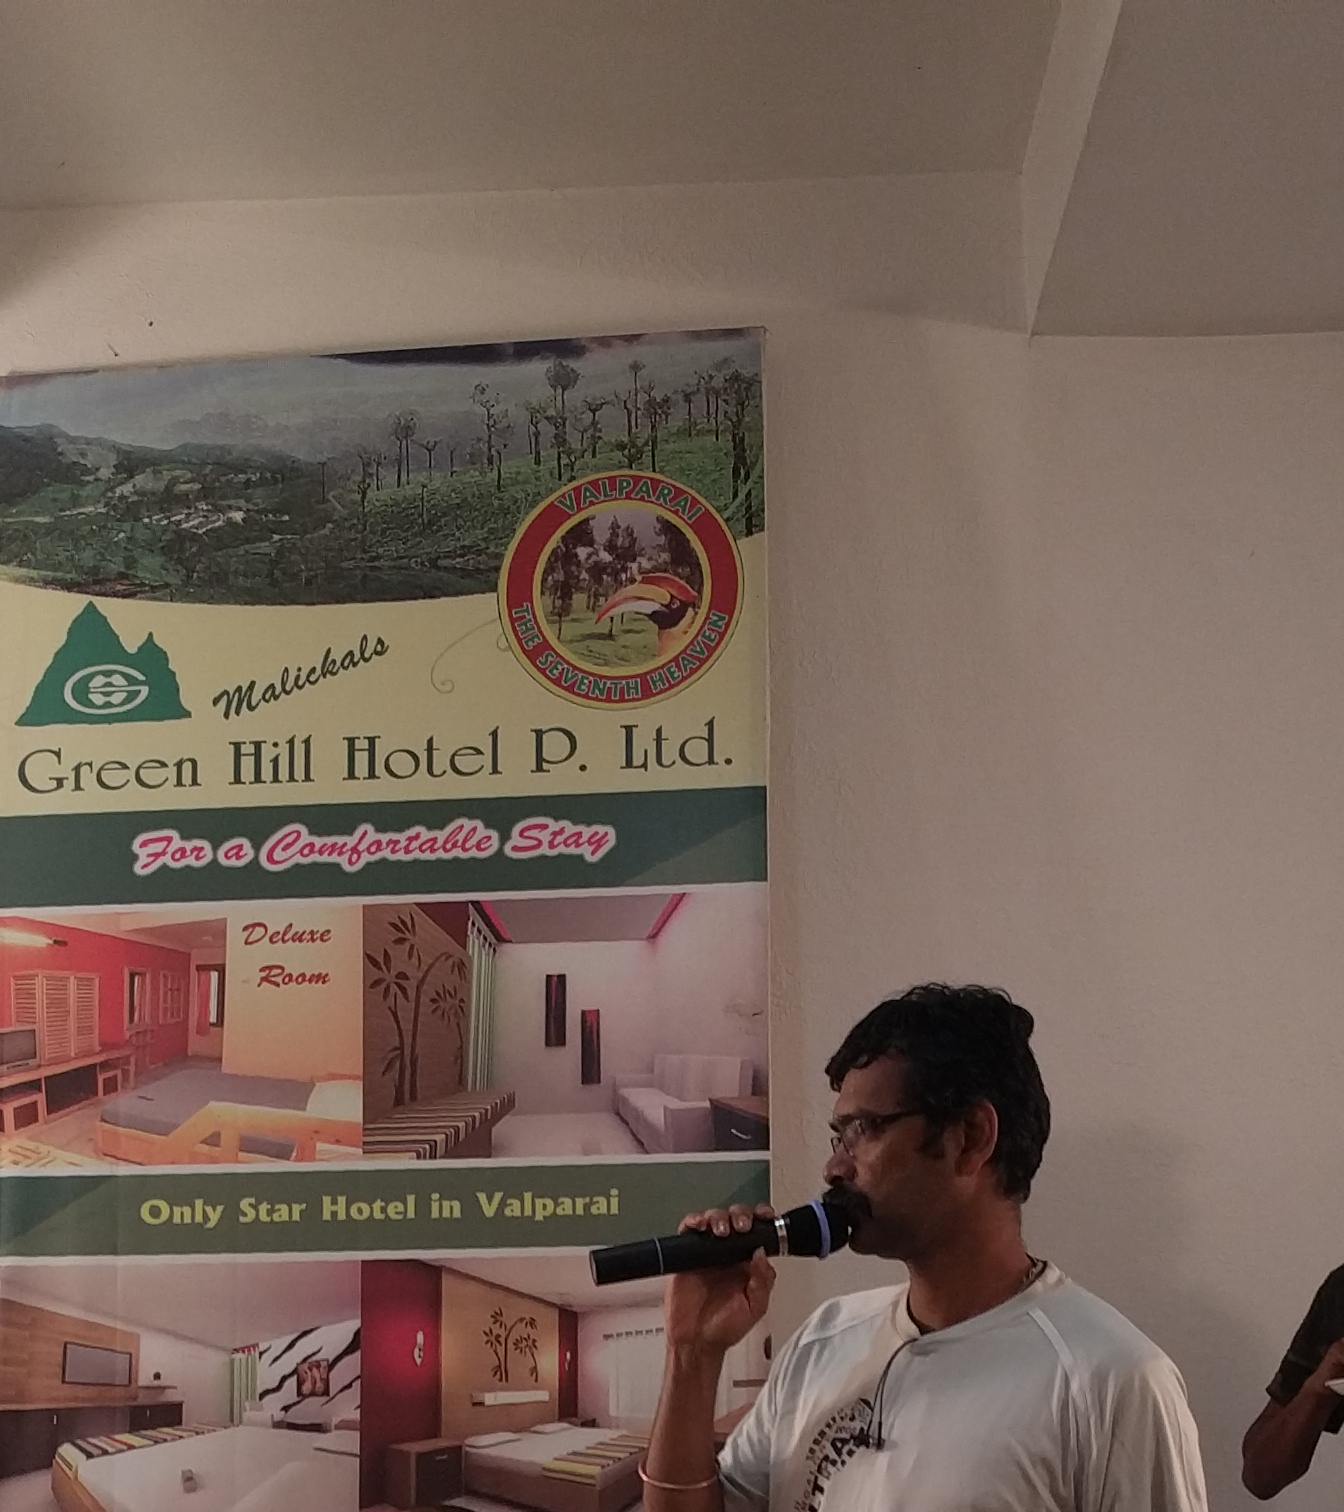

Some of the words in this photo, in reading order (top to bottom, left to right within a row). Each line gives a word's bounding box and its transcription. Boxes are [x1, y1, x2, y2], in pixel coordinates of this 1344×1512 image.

[554, 477, 705, 524] VALPARAI
[511, 602, 544, 650] THE
[535, 651, 641, 700] SEVENTH
[648, 611, 729, 693] HEAVEN
[211, 633, 391, 722] Malickals
[16, 747, 203, 795] Green
[228, 734, 316, 788] Hill
[342, 726, 503, 781] Hotel
[529, 727, 588, 775] P.
[619, 716, 734, 773] Ltd.
[135, 836, 209, 872] For
[219, 842, 246, 865] a
[266, 825, 494, 871] Comfortable
[506, 820, 614, 862] Stay
[241, 921, 333, 947] Deluxe
[256, 963, 331, 990] Room
[140, 1197, 226, 1230] Only
[239, 1196, 307, 1224] Star
[322, 1194, 416, 1222] Hotel
[430, 1192, 463, 1220] in
[476, 1188, 621, 1224] Valparai
